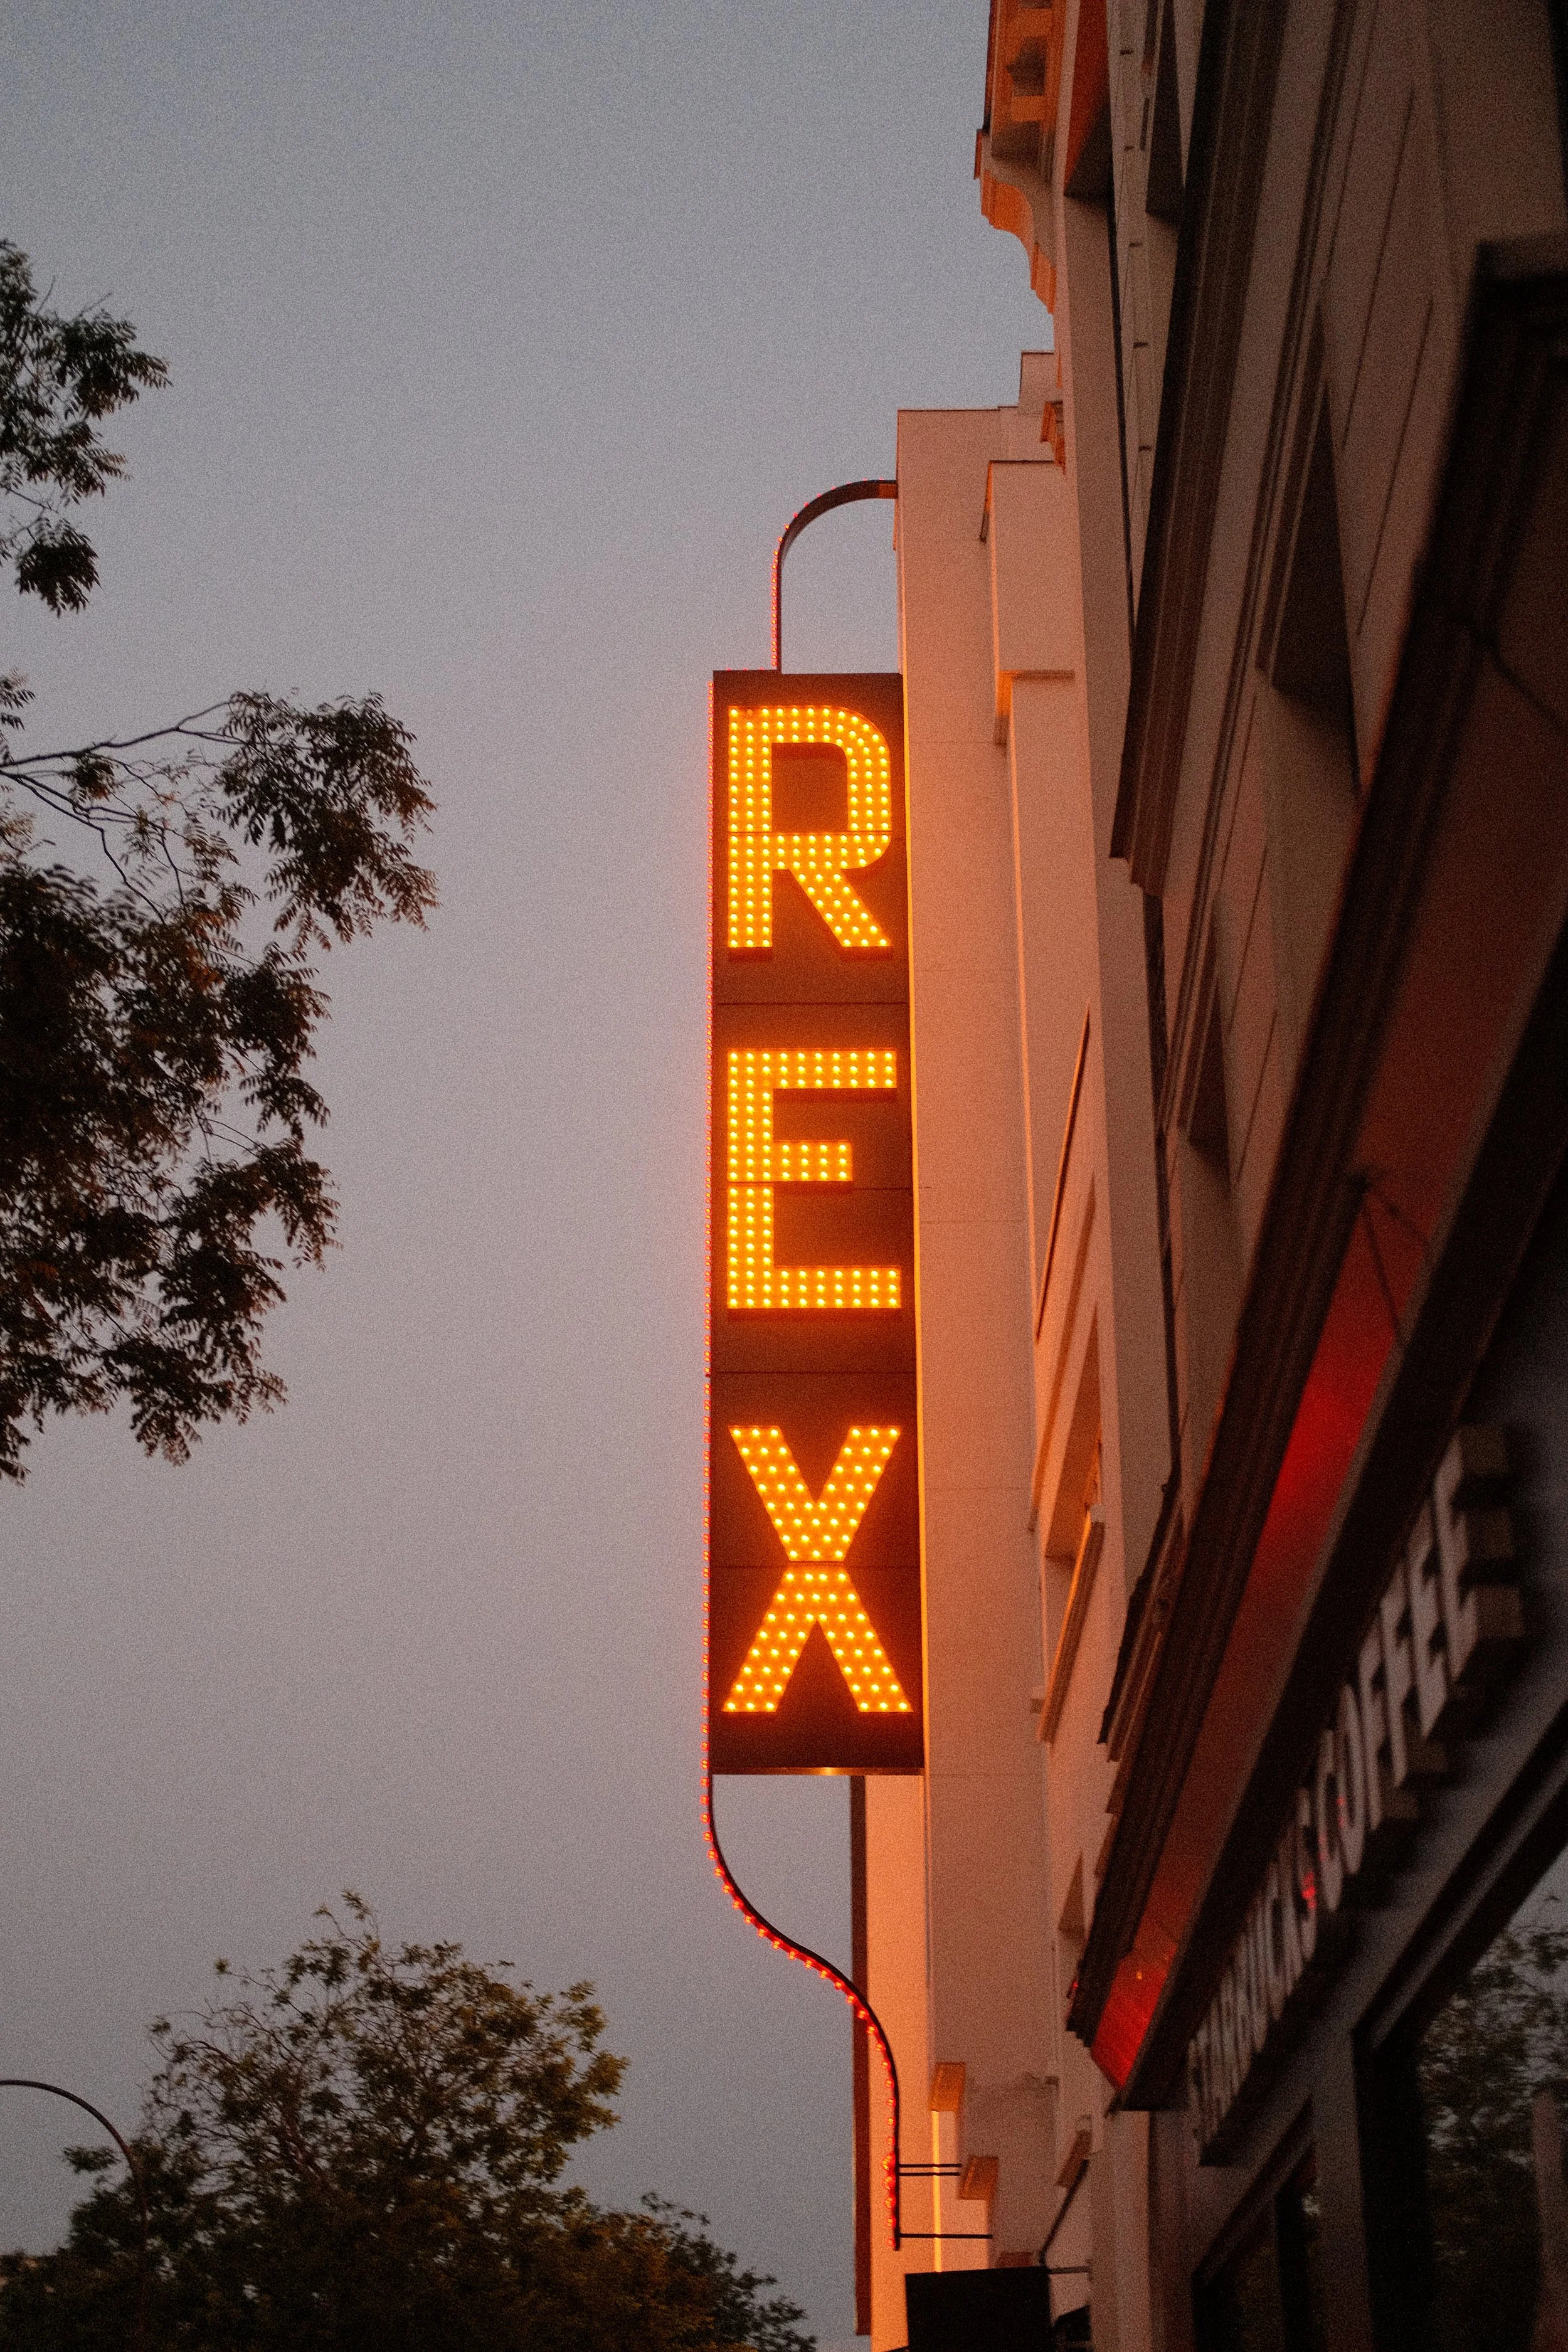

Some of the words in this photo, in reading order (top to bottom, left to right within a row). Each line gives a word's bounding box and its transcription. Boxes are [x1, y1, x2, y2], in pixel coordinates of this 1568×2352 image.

[722, 705, 913, 1714] REX
[1187, 1788, 1317, 2144] STARBUCKS
[1317, 1434, 1478, 1912] COFFEE
